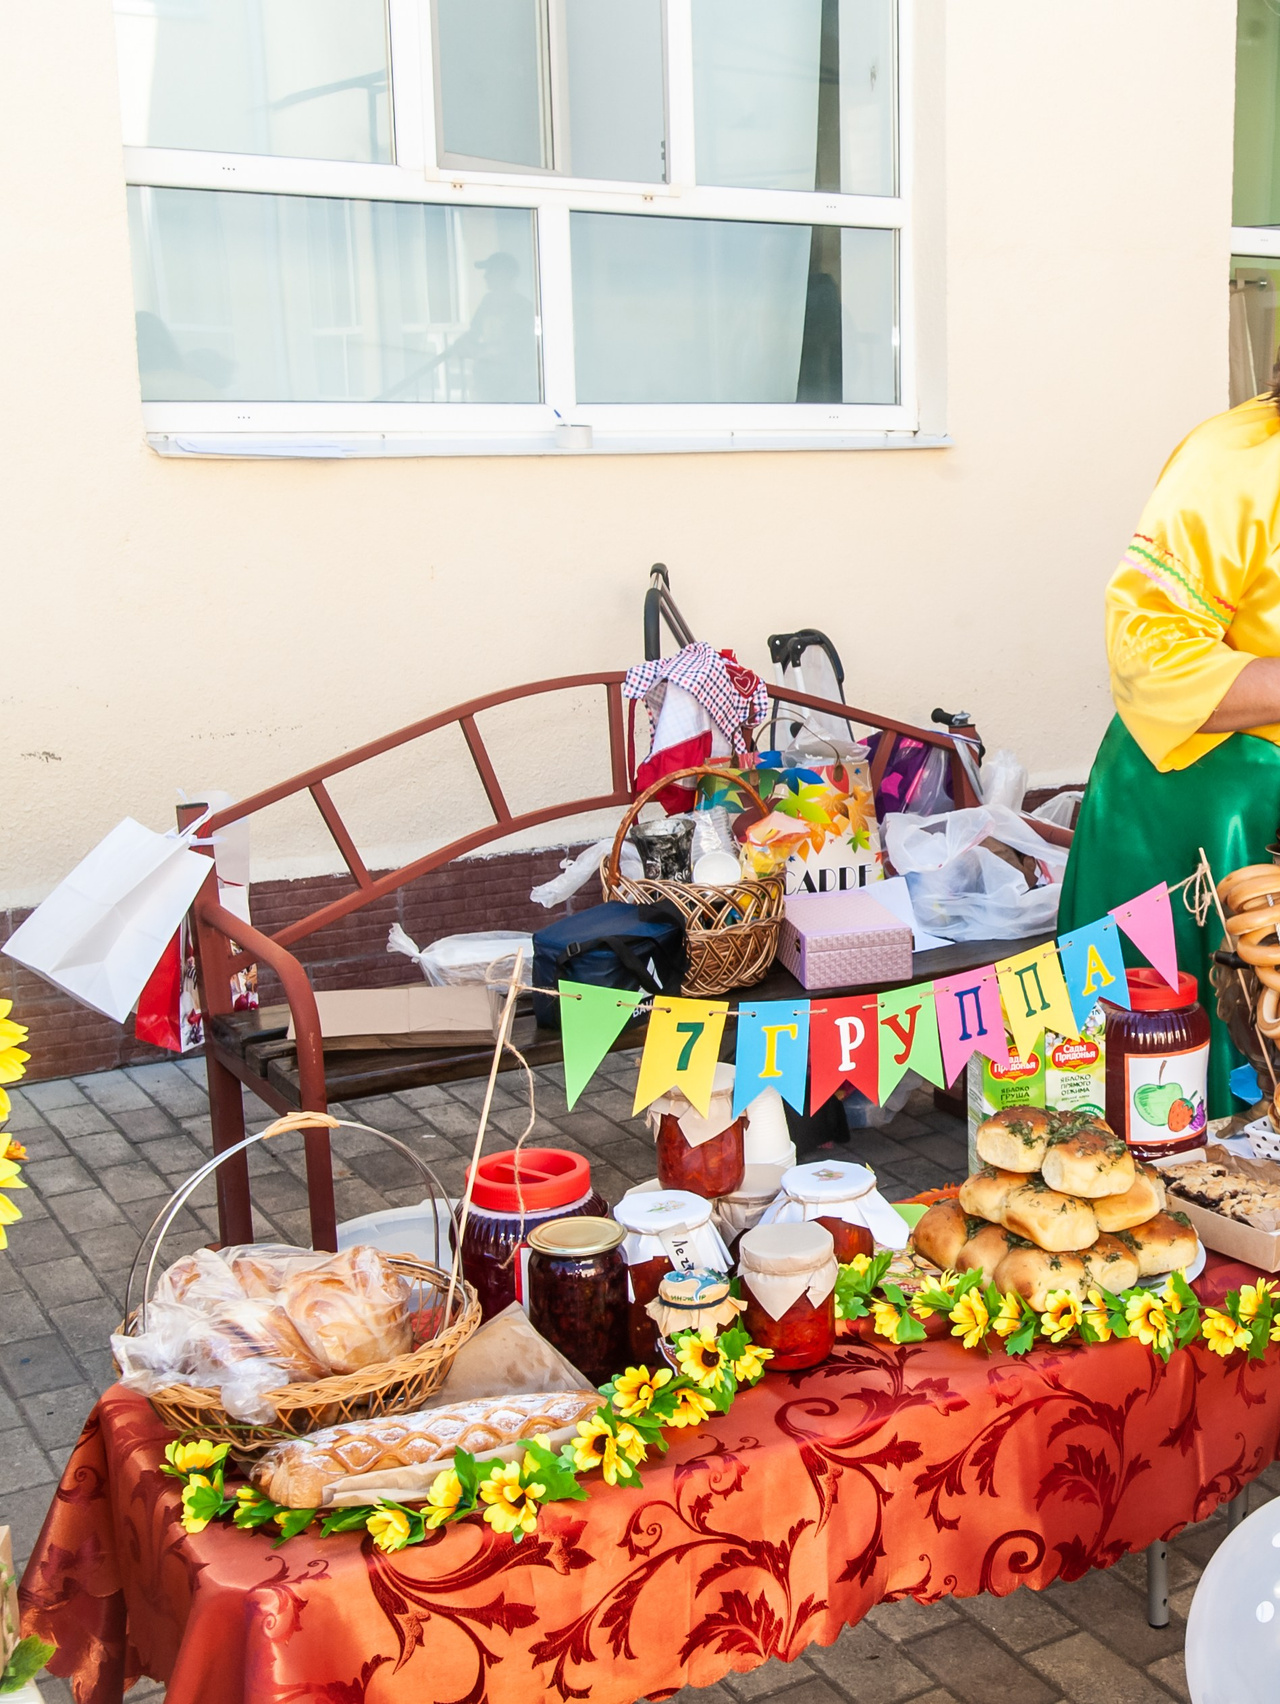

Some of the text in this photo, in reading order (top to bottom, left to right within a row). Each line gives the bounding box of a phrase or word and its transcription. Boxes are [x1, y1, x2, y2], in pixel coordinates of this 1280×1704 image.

[676, 943, 1116, 1078] 7 ГРУППА
[1063, 1044, 1087, 1054] Сады
[1055, 1050, 1096, 1063] Придонья
[994, 1061, 1036, 1074] Прдонья
[1060, 1074, 1091, 1083] ЯБЛОКО
[1060, 1081, 1091, 1089] ПРЯМОГО
[1000, 1092, 1030, 1100] ГРУША
[1061, 1087, 1090, 1096] ОТЖИМА
